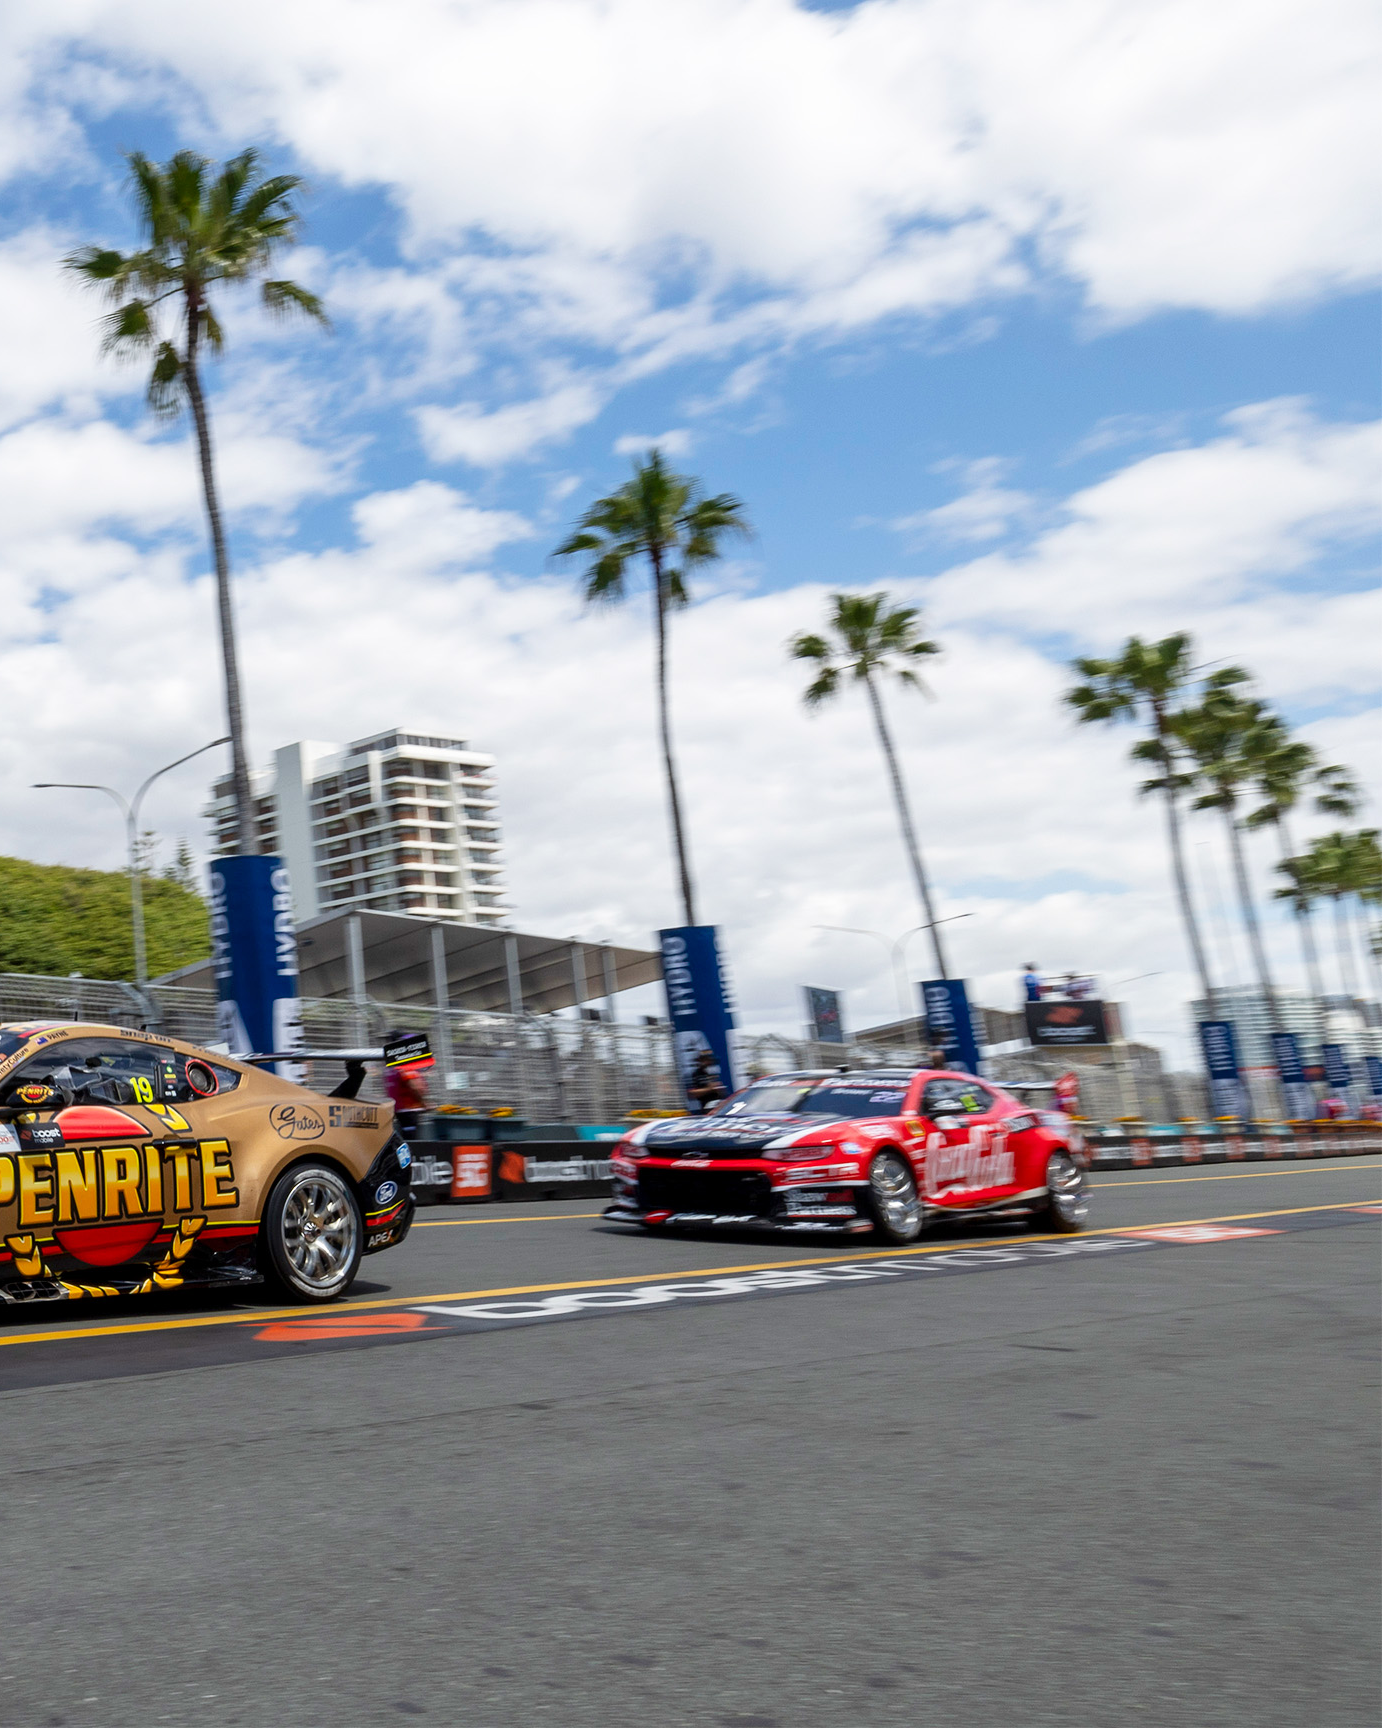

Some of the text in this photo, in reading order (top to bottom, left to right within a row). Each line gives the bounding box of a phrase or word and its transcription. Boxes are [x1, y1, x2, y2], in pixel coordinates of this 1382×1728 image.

[130, 1077, 153, 1103] 19
[32, 1127, 61, 1137] boost
[368, 1229, 395, 1247] APEX
[404, 1238, 1156, 1320] boostmobile
